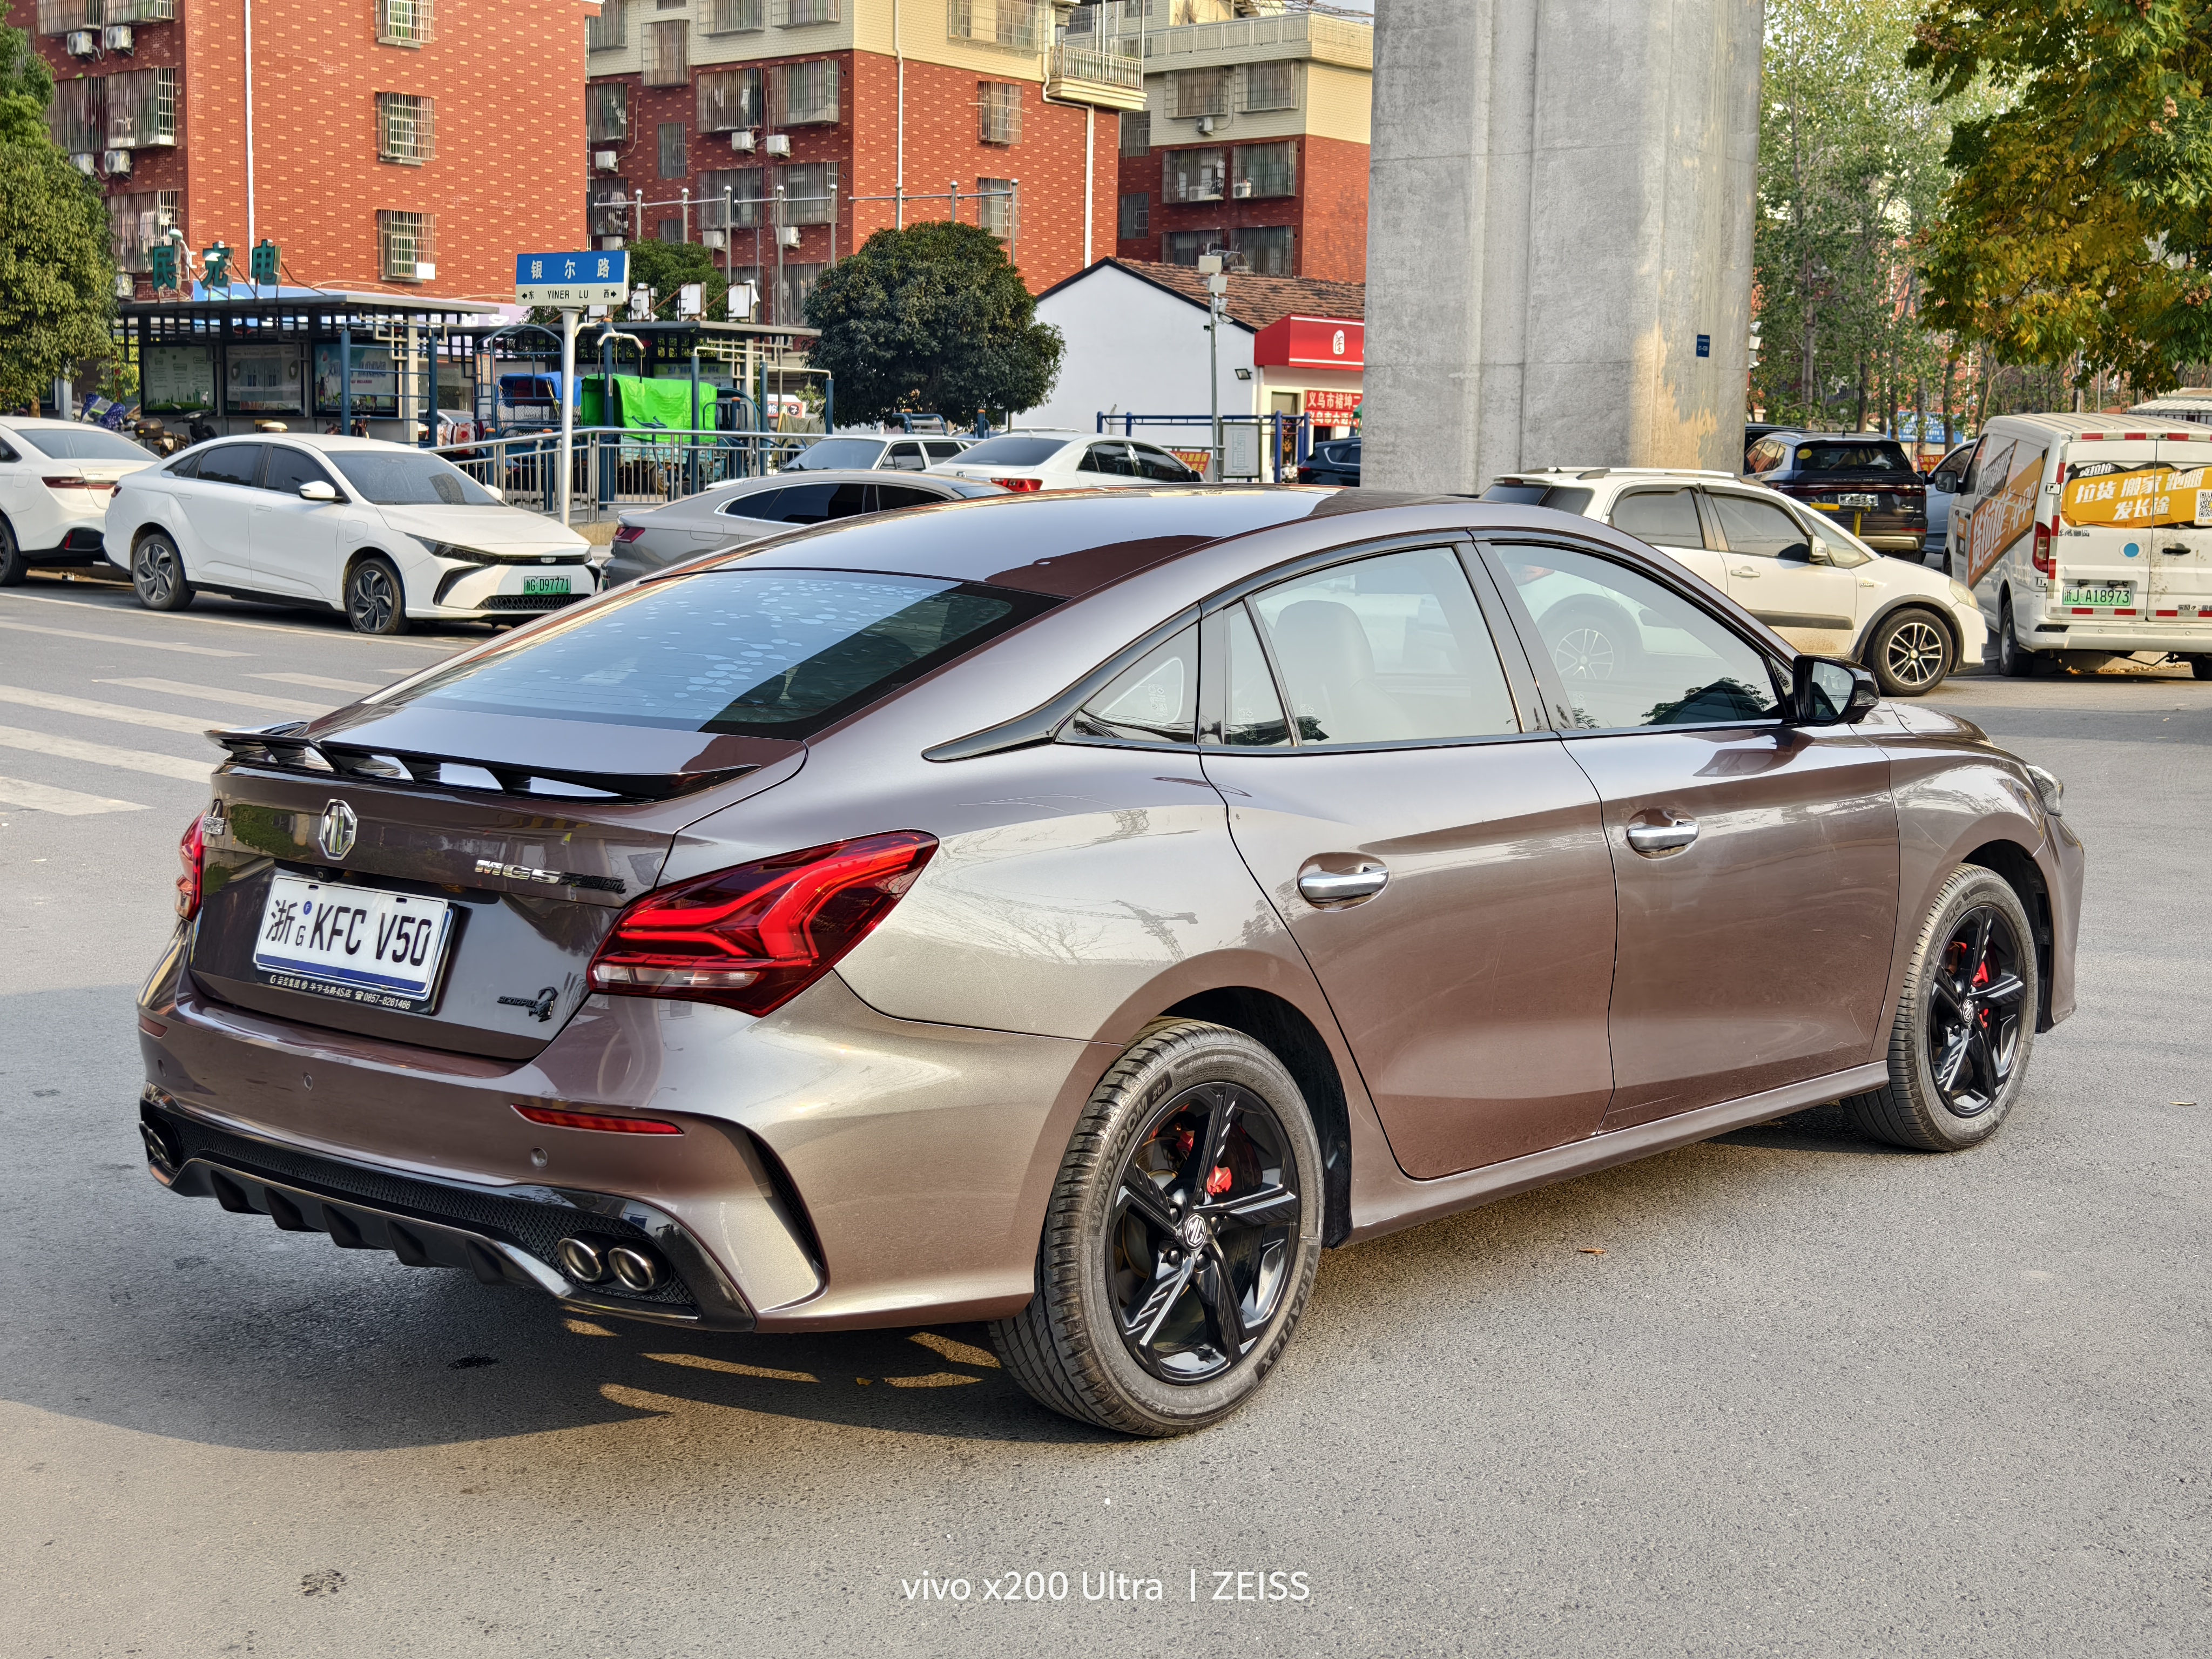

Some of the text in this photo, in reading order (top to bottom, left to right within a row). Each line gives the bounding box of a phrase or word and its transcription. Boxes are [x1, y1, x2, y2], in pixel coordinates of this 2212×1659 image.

[531, 258, 610, 280] 银尔路
[548, 290, 589, 299] YINER LU
[604, 289, 610, 298] 西
[2074, 469, 2205, 504] 拉货 搬家 跑腿
[322, 805, 355, 854] MG
[309, 903, 367, 955] KFC
[375, 913, 432, 967] V50
[497, 996, 539, 1007] SCORPIO
[1188, 1218, 1205, 1244] MG
